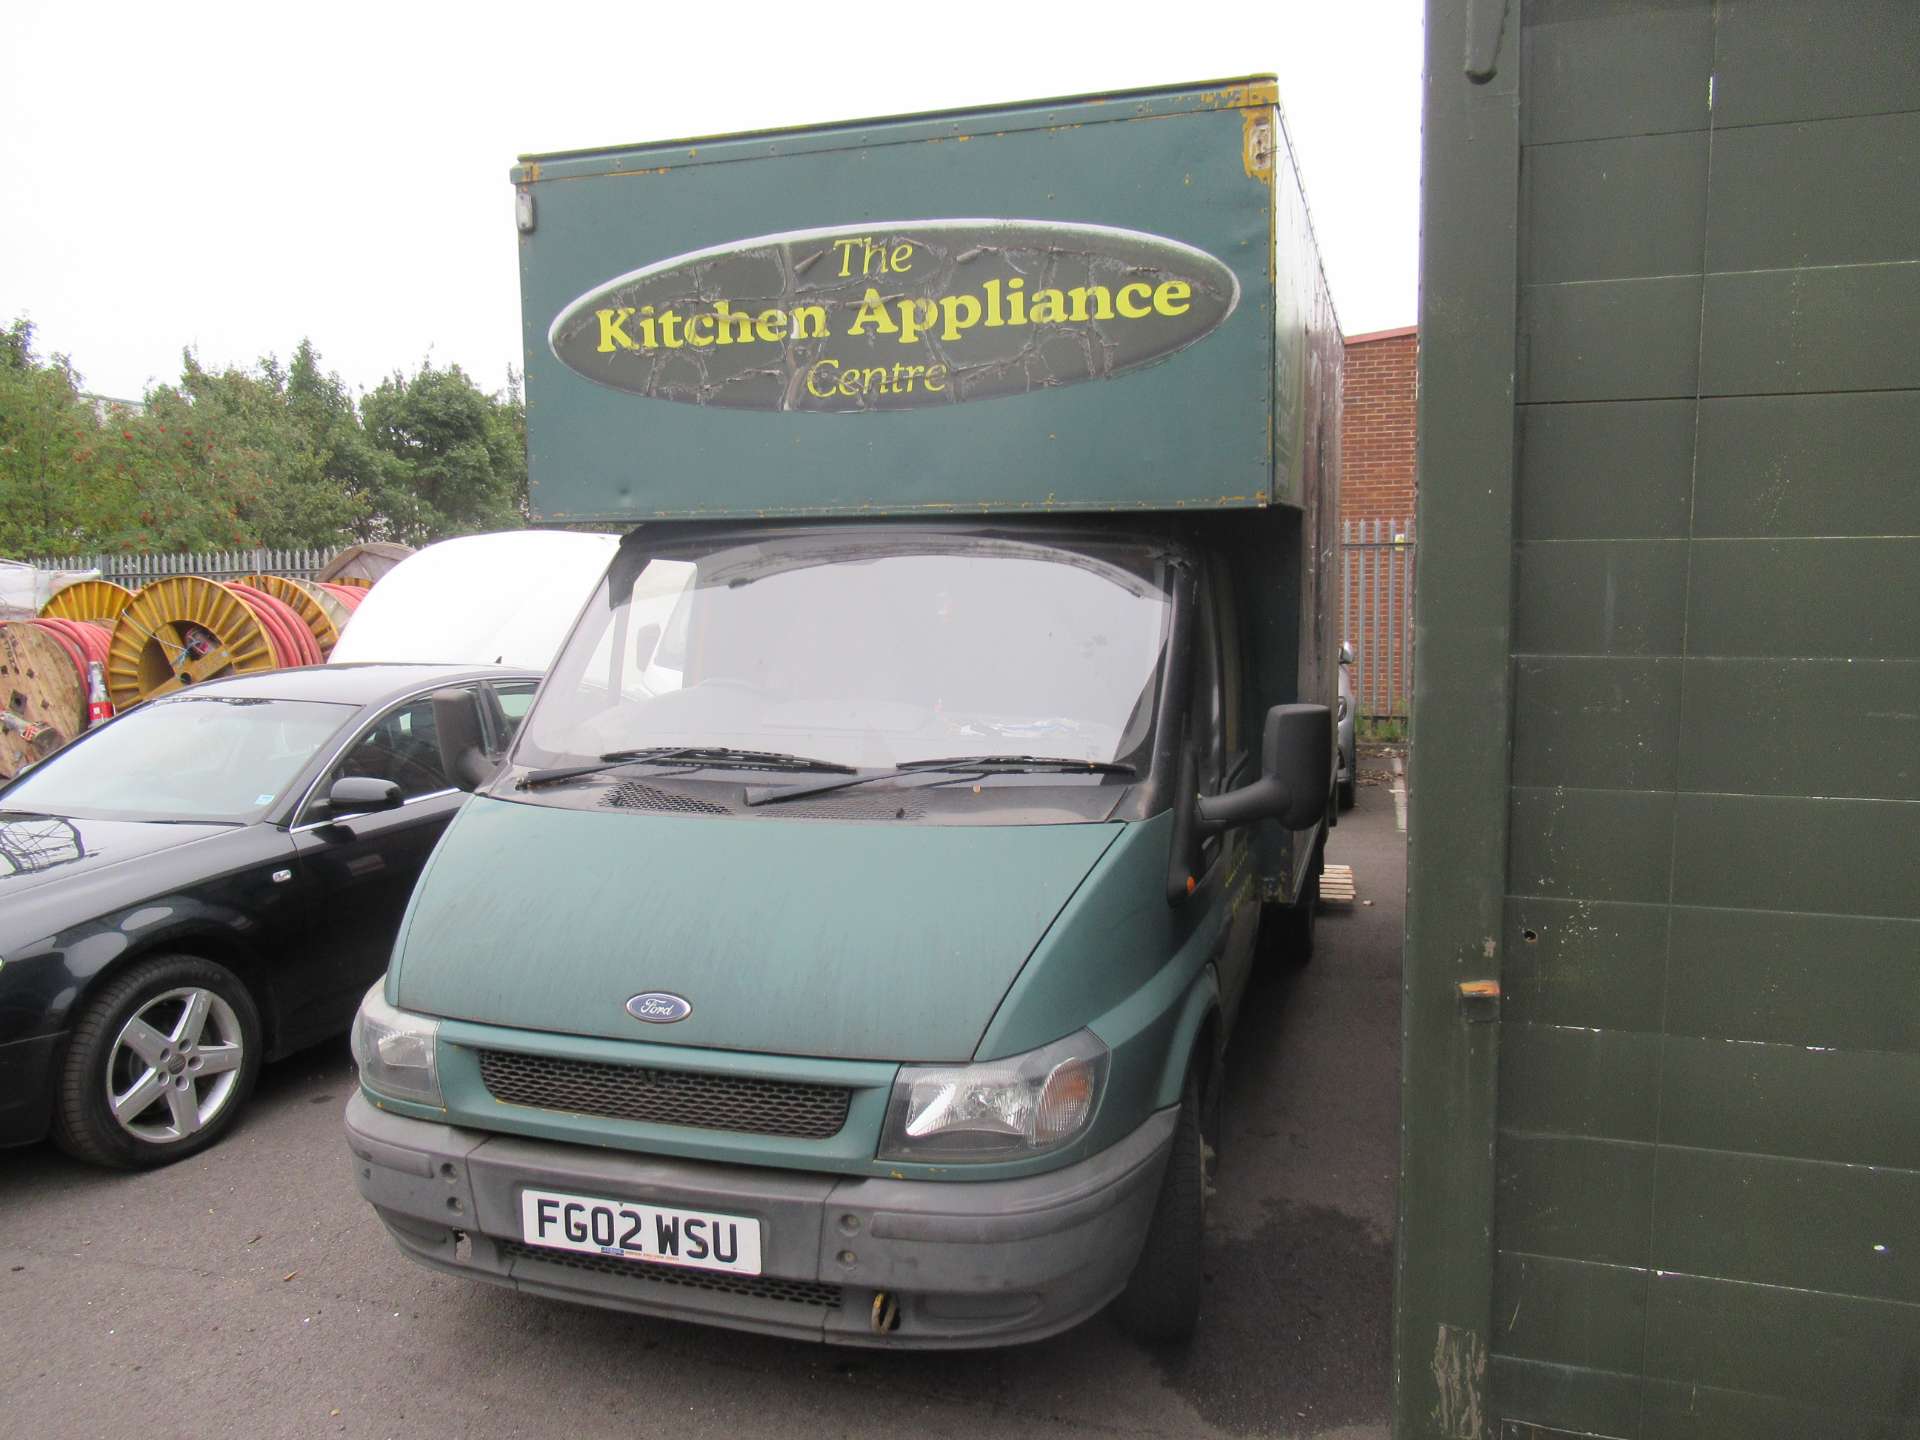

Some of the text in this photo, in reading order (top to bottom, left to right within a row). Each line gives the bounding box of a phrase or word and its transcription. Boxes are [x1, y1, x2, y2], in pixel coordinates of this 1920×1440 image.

[834, 237, 914, 279] The
[595, 277, 1192, 353] Kitchen Appliance
[805, 358, 947, 398] Centre
[640, 998, 675, 1016] Ford
[537, 1198, 738, 1263] FG02 WSU
